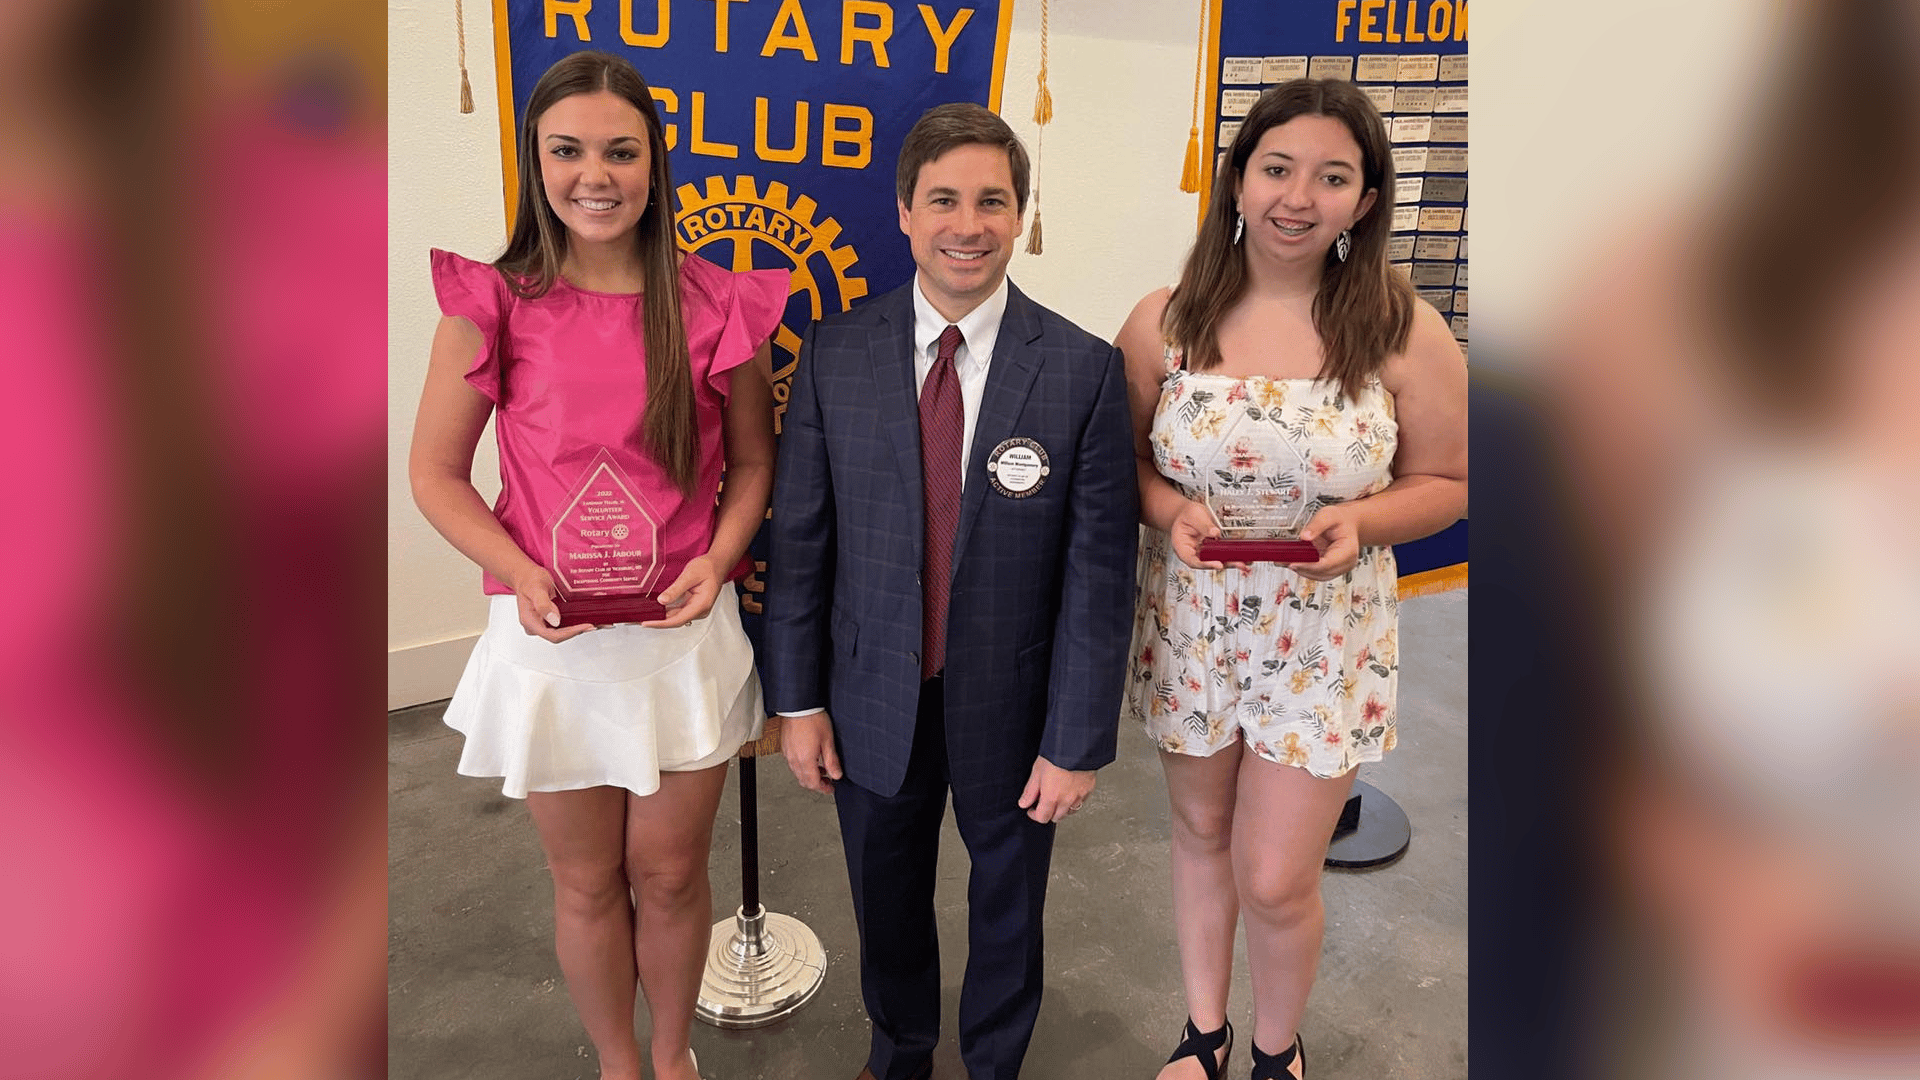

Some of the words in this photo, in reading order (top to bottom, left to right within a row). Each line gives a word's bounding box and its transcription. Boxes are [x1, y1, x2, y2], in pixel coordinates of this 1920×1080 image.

[544, 0, 975, 74] ROTARY
[682, 204, 811, 250] ROTARY
[994, 439, 1028, 457] ROTARY
[990, 478, 1013, 498] ACTIVE
[1015, 479, 1044, 498] MEMBER
[580, 530, 610, 538] Rotary
